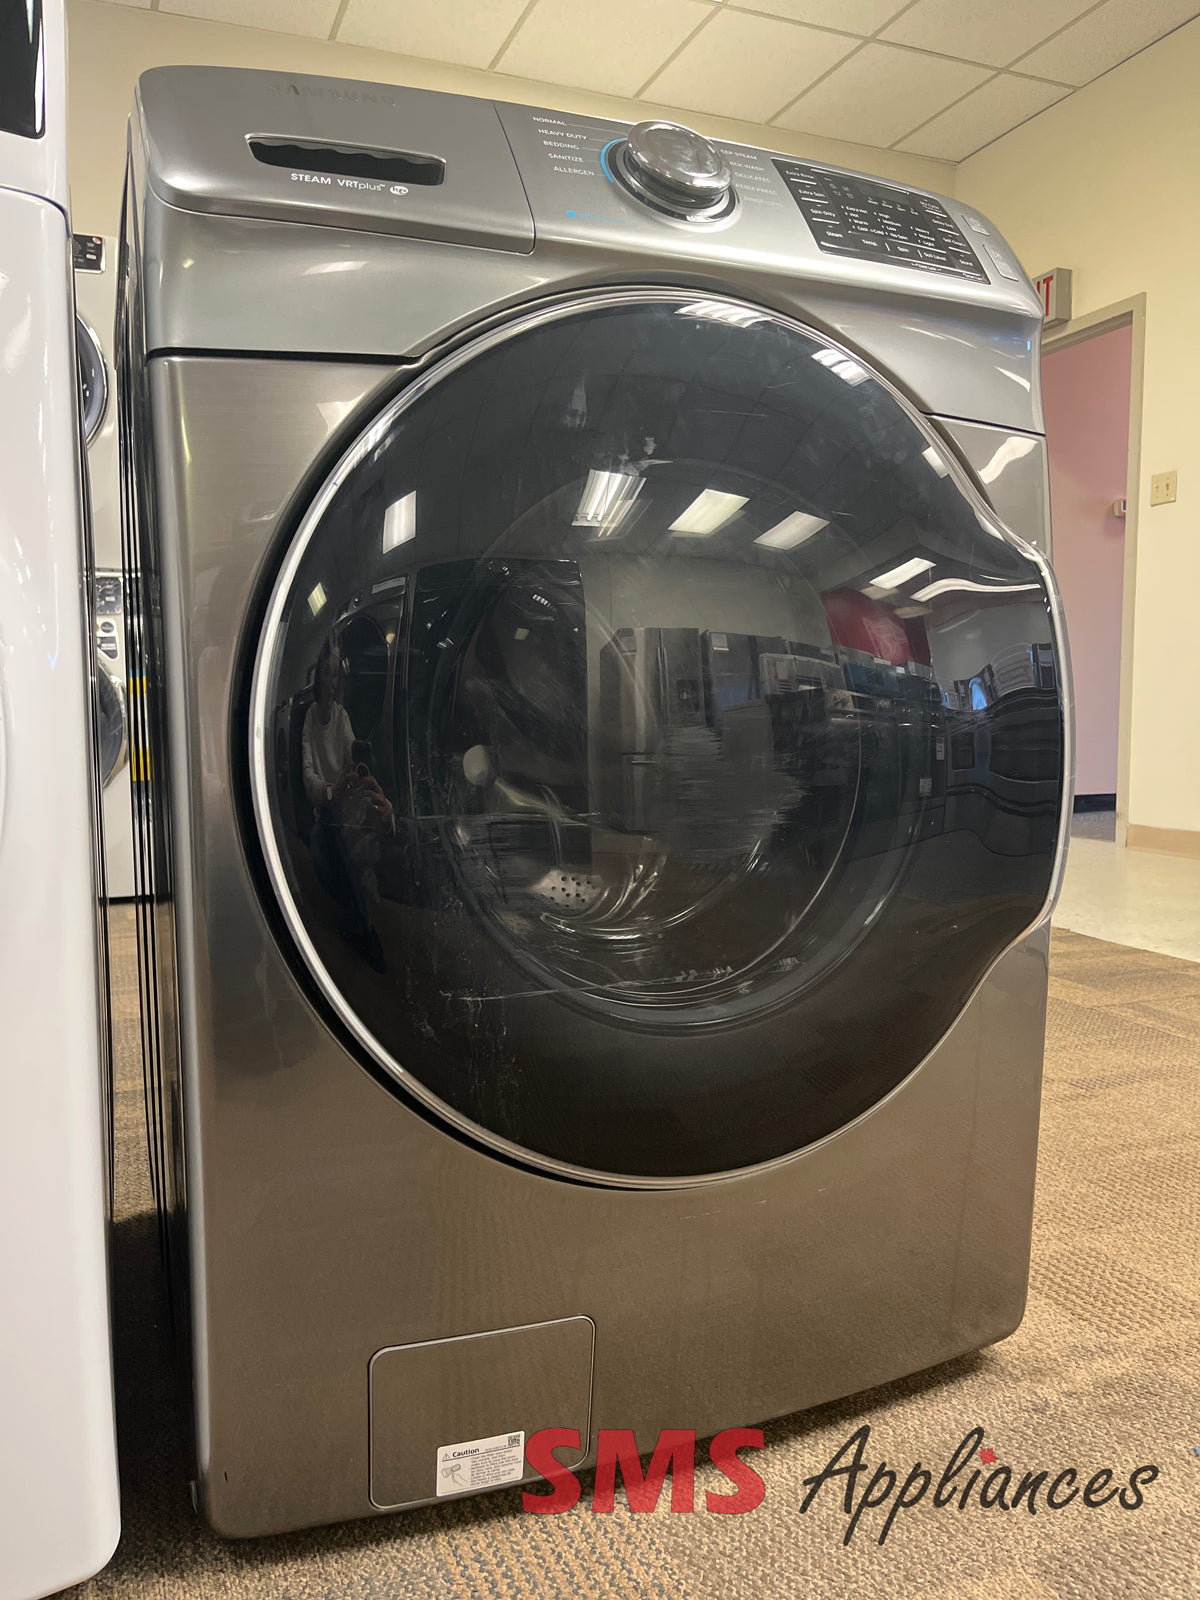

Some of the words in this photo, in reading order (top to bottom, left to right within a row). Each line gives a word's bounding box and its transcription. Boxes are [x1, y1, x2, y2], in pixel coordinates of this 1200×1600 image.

[532, 116, 567, 126] NORMAL
[538, 128, 564, 137] HEAVY
[566, 132, 587, 140] DUTY
[543, 140, 580, 150] BEDDING
[548, 152, 585, 163] SANITIZE
[553, 165, 595, 176] ALLERGEN
[291, 173, 332, 185] STEAM
[452, 1448, 480, 1458] Caution
